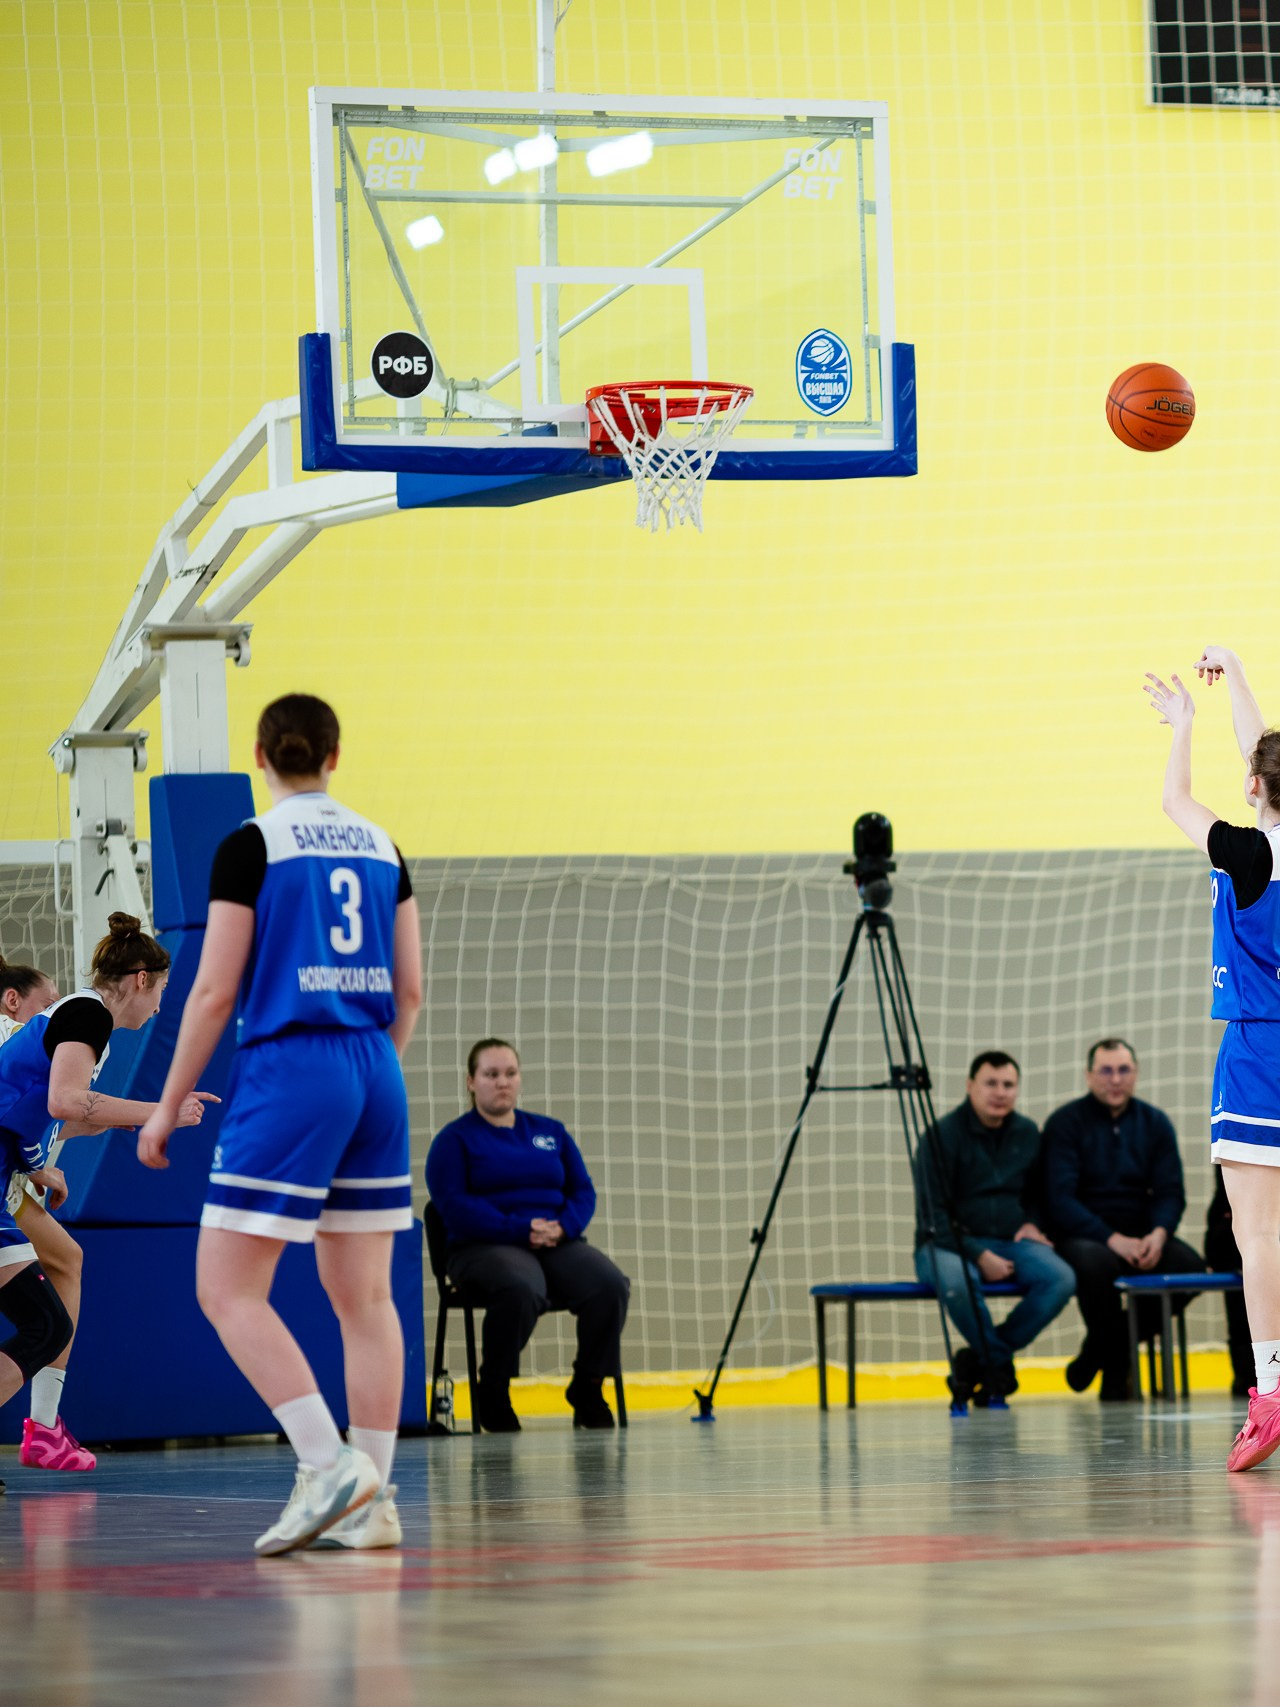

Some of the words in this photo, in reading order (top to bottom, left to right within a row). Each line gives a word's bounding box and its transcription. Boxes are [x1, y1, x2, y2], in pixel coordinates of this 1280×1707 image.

[366, 136, 425, 161] FON
[784, 148, 842, 173] FON
[364, 164, 424, 190] BET
[784, 175, 843, 200] BET
[378, 355, 428, 375] РФБ
[809, 372, 840, 380] FONBET
[805, 382, 844, 396] ВЫСШАЯ
[291, 824, 378, 853] БАЖЕНОВА
[329, 868, 364, 955] 3
